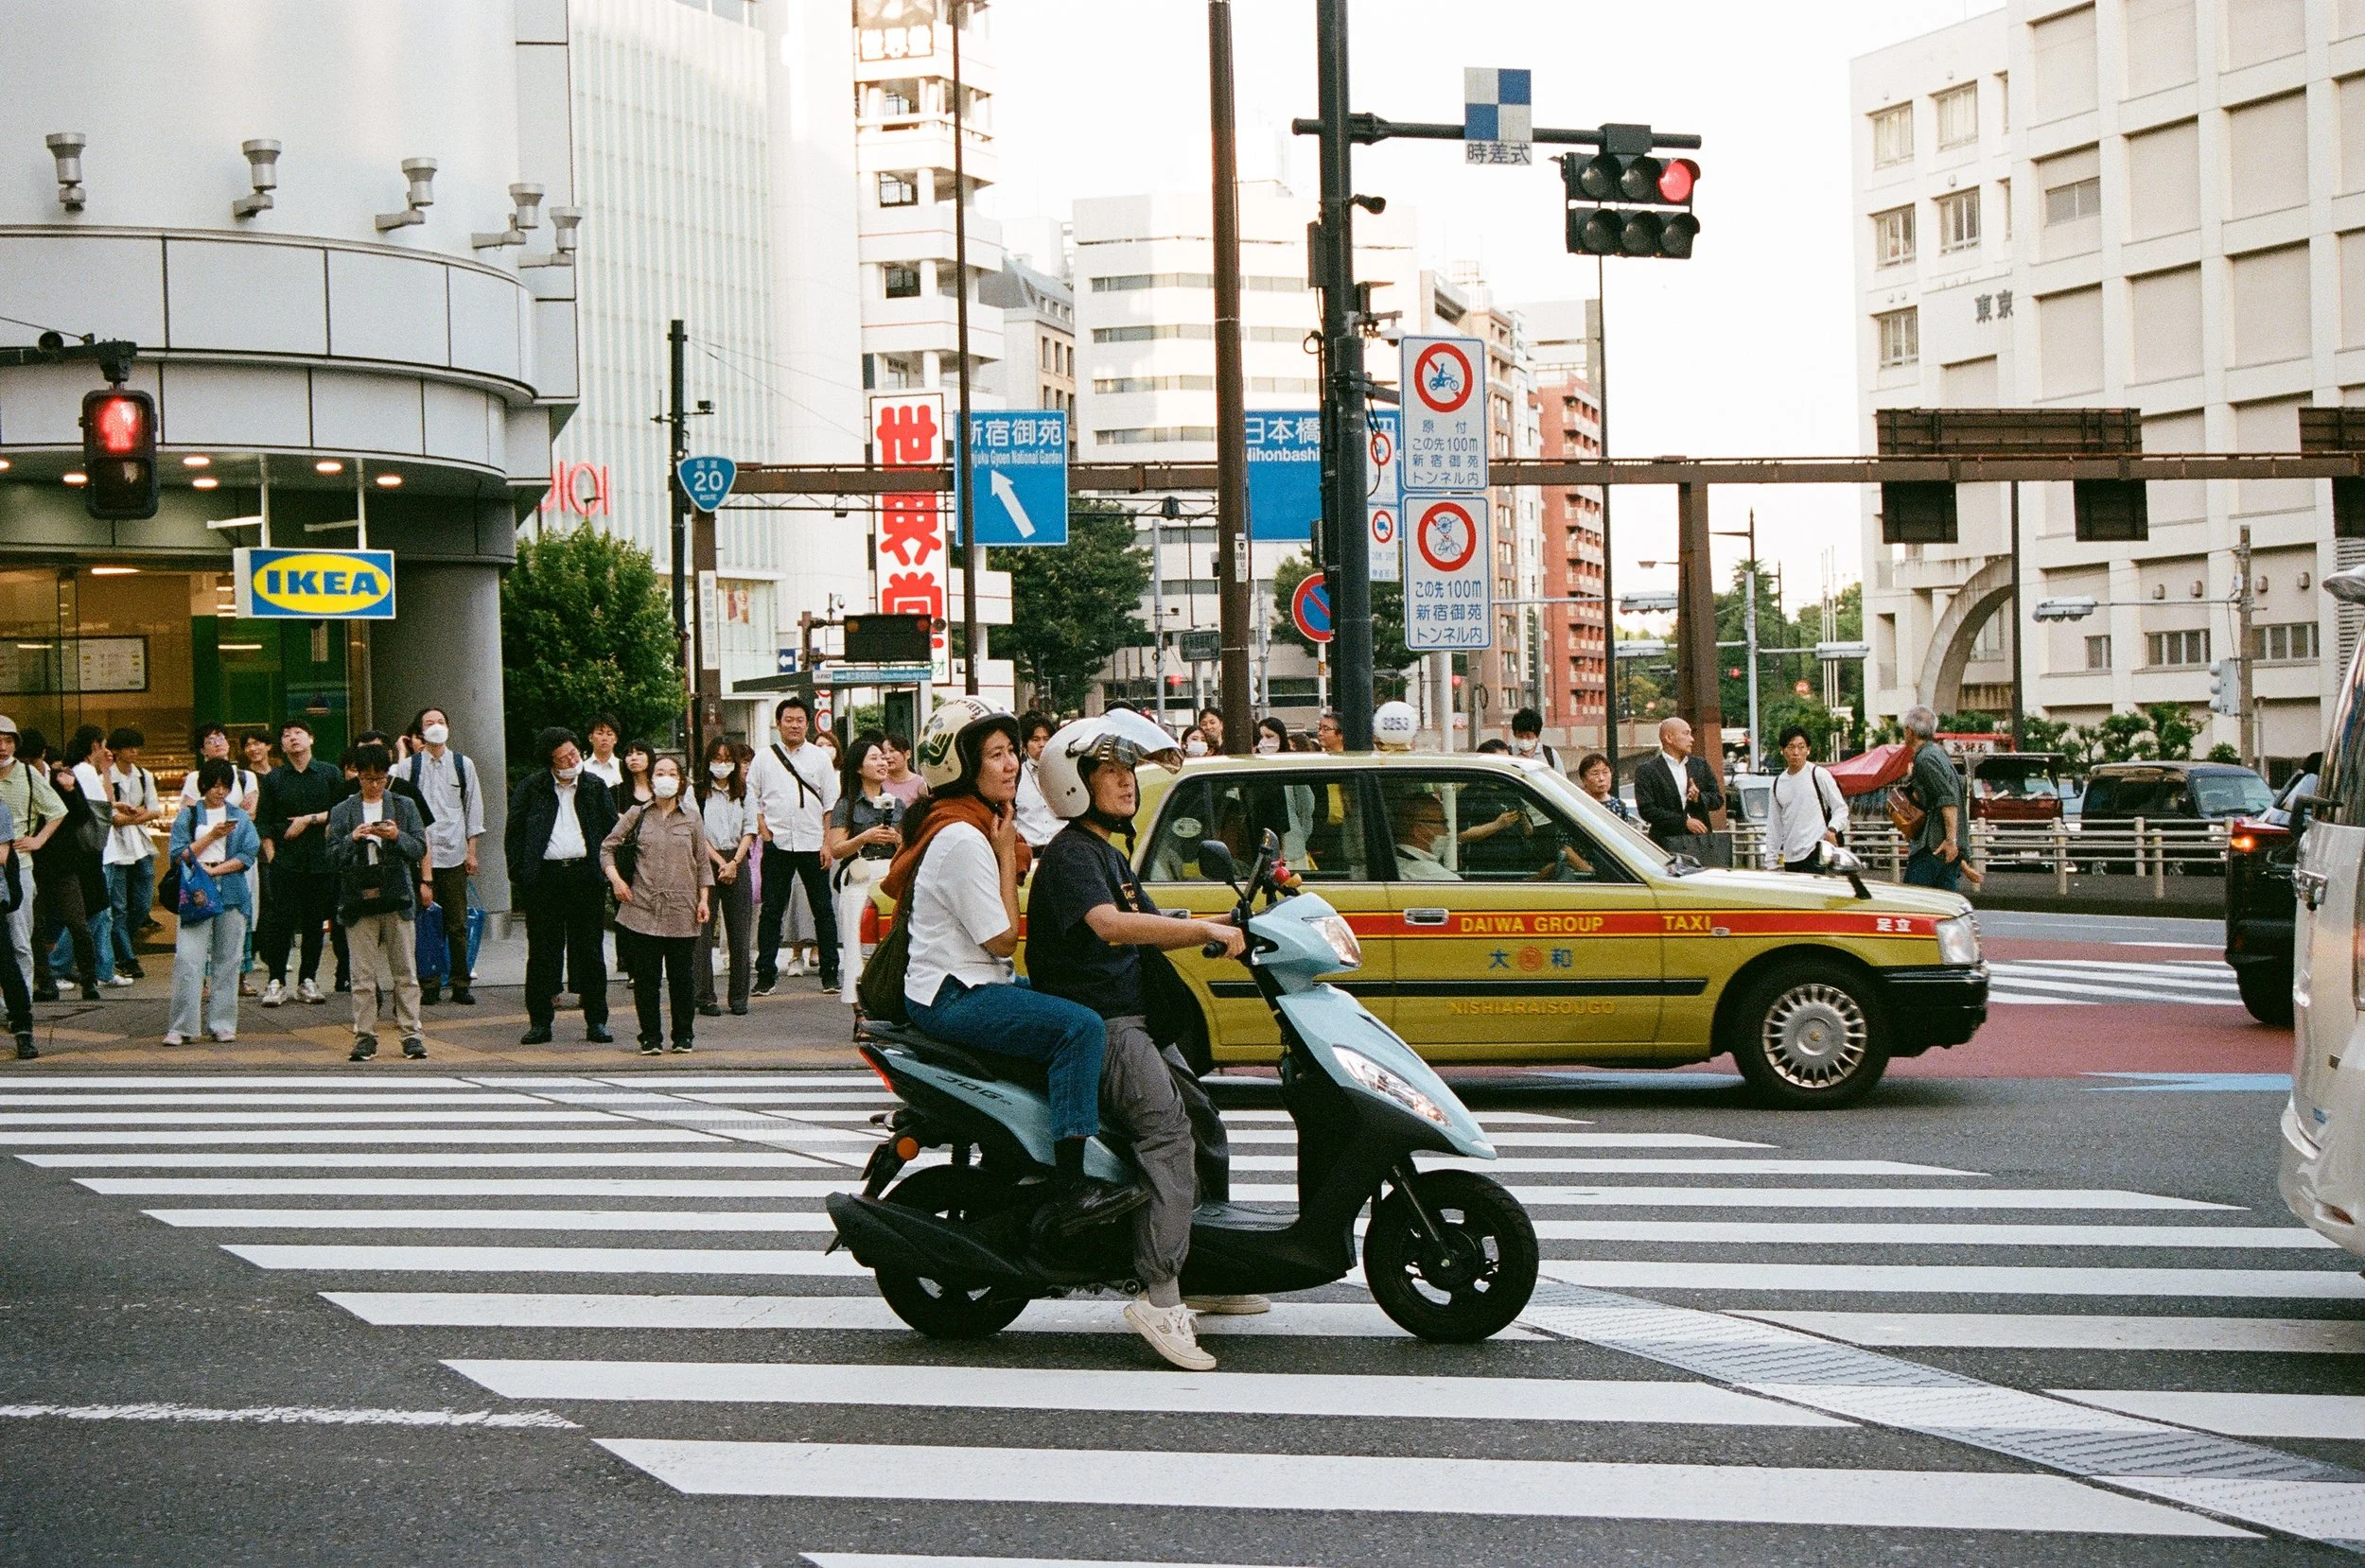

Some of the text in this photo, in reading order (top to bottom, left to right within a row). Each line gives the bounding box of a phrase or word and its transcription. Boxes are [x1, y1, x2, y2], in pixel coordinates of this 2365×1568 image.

[1467, 143, 1531, 164] 時差式
[1974, 289, 2013, 322] 東京
[1245, 417, 1320, 444] 日本橋
[1412, 454, 1479, 468] 新宿御苑
[693, 471, 723, 492] 20
[1413, 472, 1480, 485] トンネル内
[267, 570, 380, 595] IKEA
[1416, 603, 1482, 620] 新宿御苑
[1417, 626, 1482, 643] トンネル内
[1461, 915, 1711, 932] DAIWA GROUP TAXI
[1876, 917, 1912, 932] 足立
[1488, 948, 1511, 969] 大
[1447, 1000, 1617, 1016] NISHIARAISOUGO
